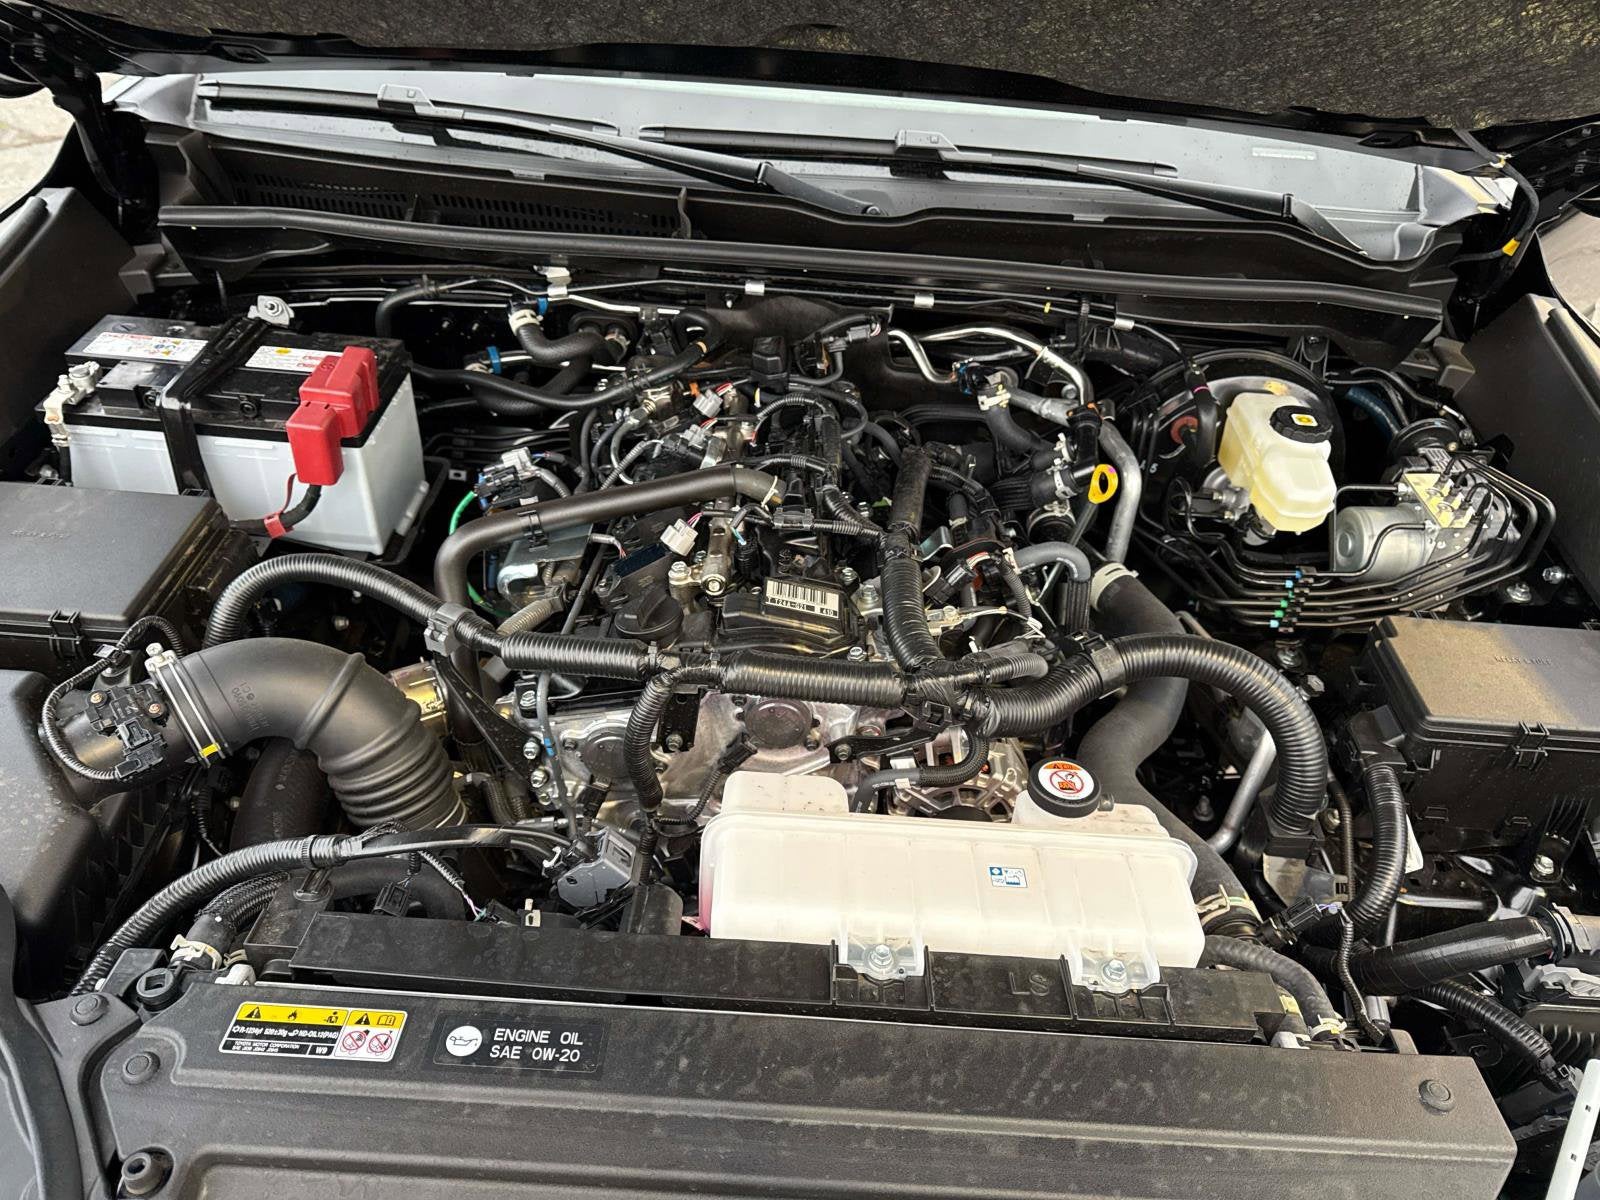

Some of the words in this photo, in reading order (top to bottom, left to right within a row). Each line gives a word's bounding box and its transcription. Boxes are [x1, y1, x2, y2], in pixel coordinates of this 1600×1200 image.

[1009, 971, 1050, 997] LS
[493, 1028, 551, 1044] ENGINE
[559, 1031, 584, 1046] OIL
[315, 1046, 328, 1055] W9
[489, 1045, 523, 1060] SAE
[531, 1047, 581, 1063] 0W-20
